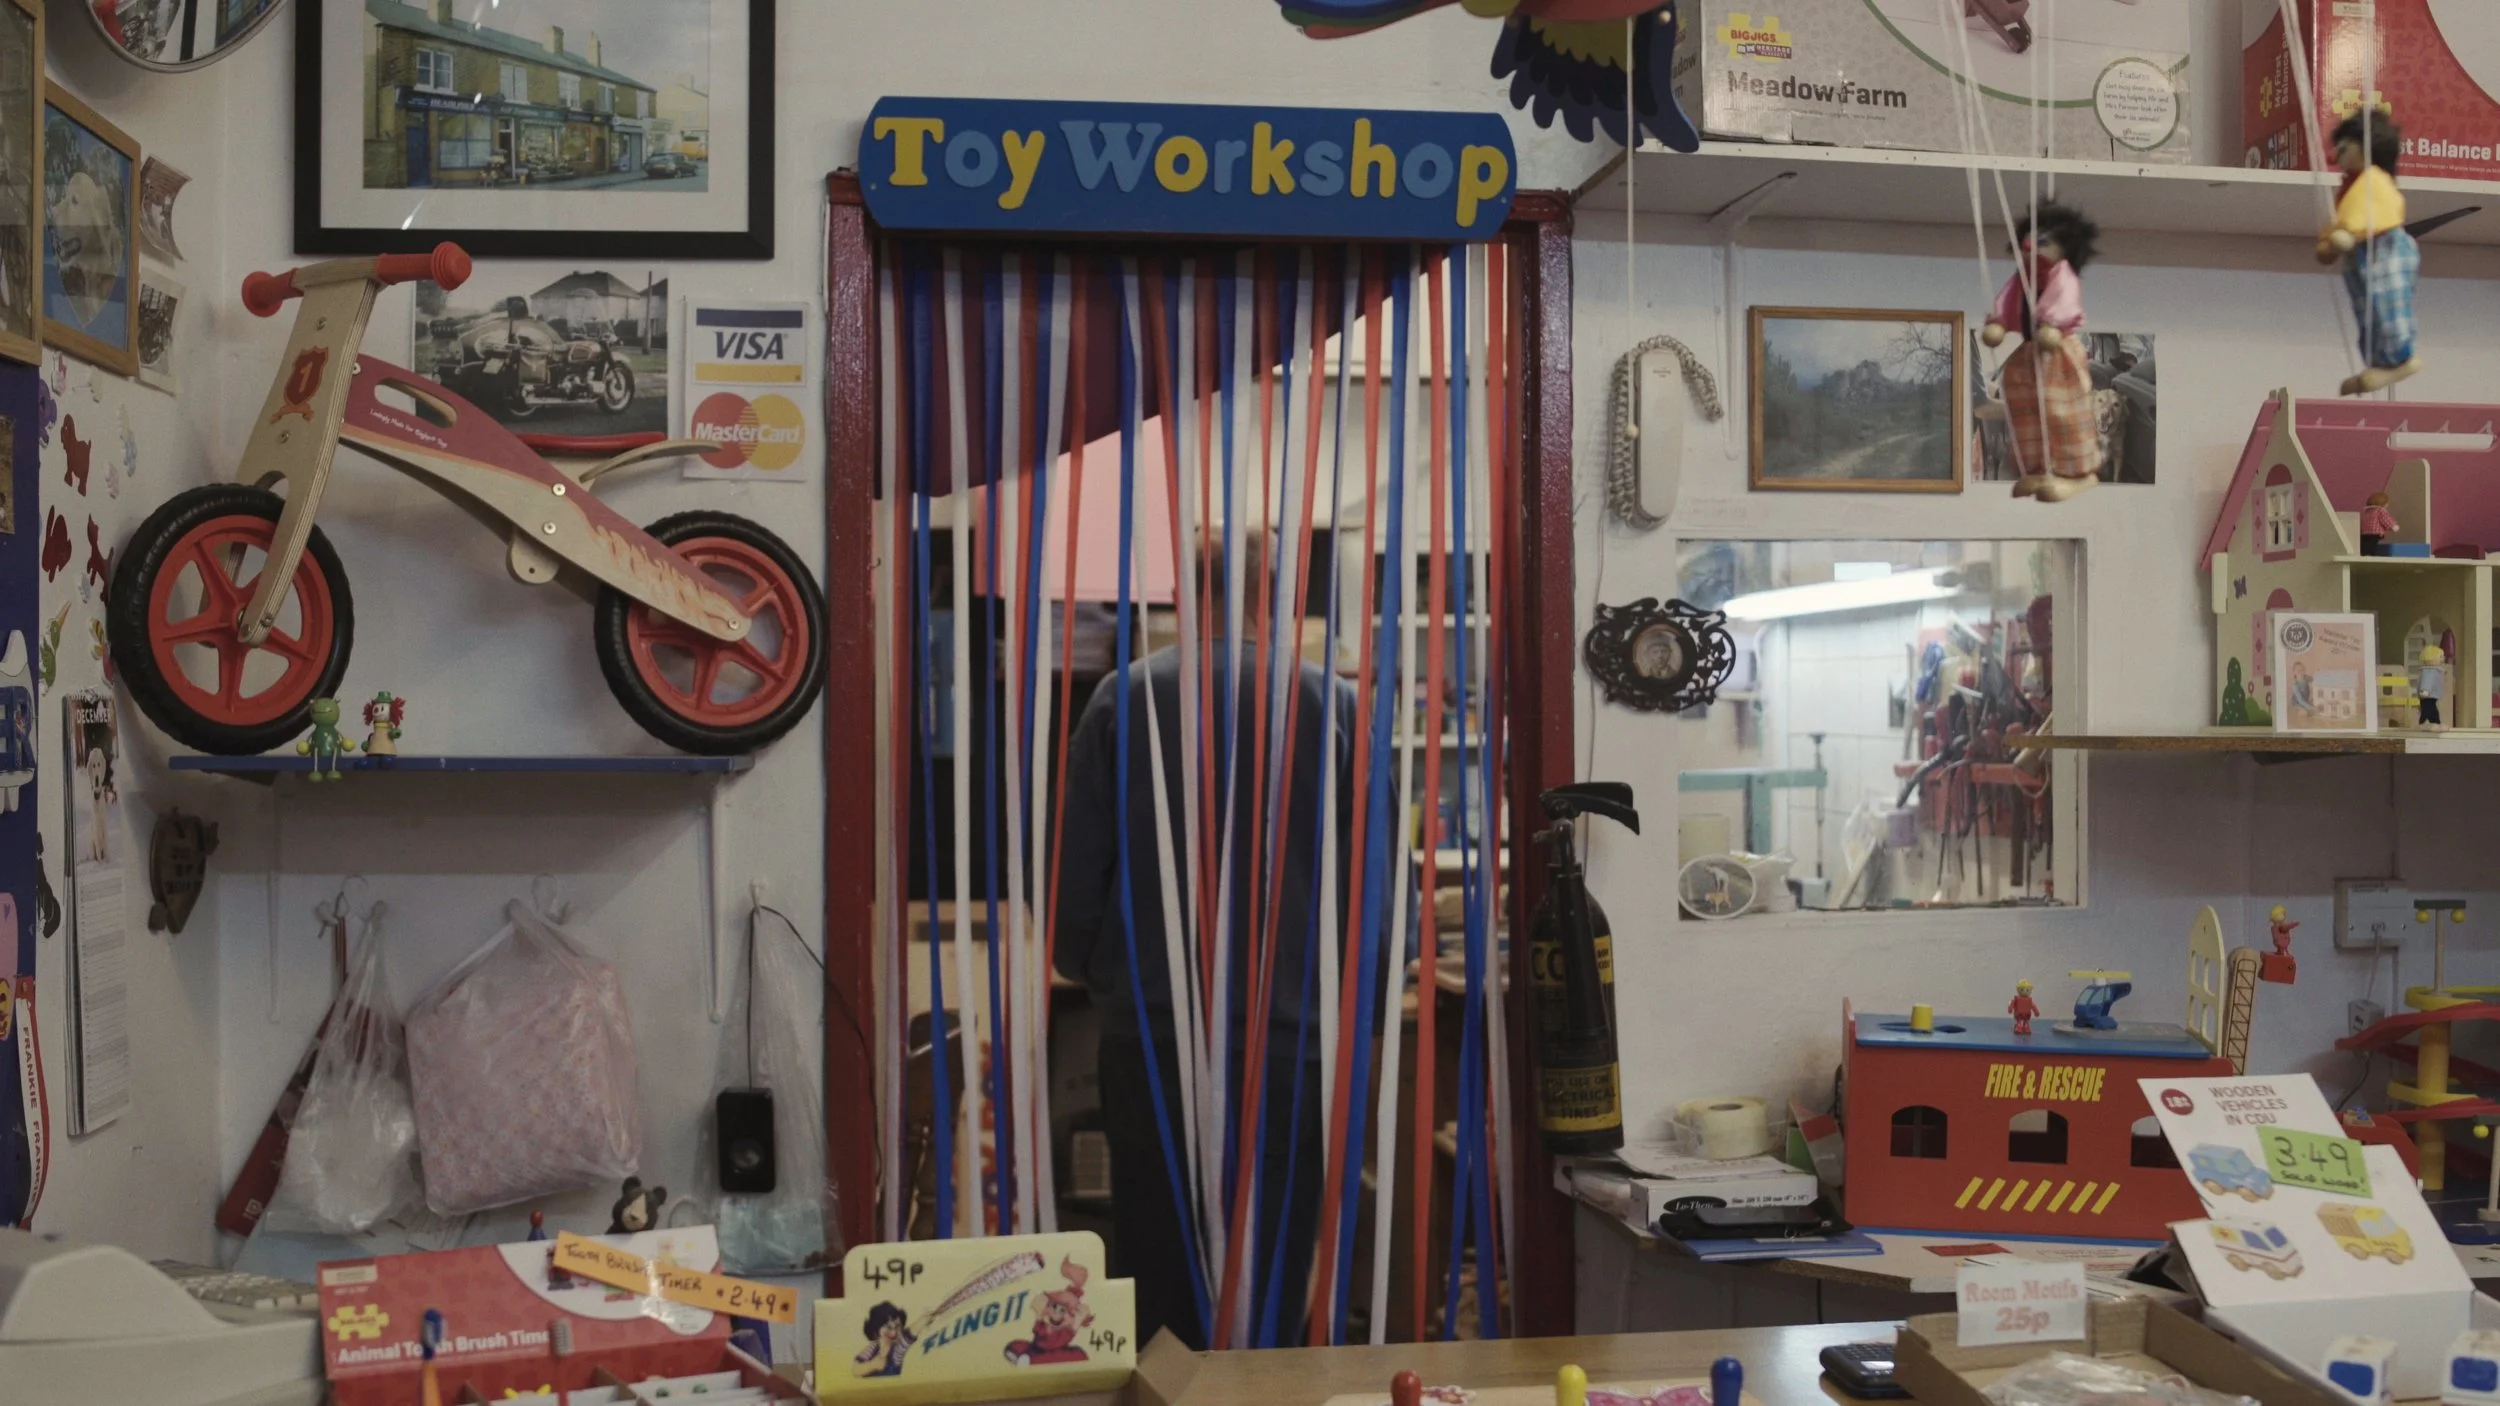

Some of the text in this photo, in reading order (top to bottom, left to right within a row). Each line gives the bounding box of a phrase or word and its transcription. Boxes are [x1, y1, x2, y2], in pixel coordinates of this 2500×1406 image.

[1727, 69, 1908, 108] Meadow Farm
[2417, 136, 2492, 161] Balance
[874, 116, 1509, 228] Toy Workshop
[715, 331, 784, 360] VISA
[695, 422, 802, 444] MasterCard
[22, 1026, 40, 1110] FRANKIE
[1984, 1063, 2107, 1102] FIRE & RESCUE
[2208, 1084, 2276, 1098] WOODEN
[2216, 1098, 2289, 1112] VEHICLES
[2225, 1112, 2277, 1125] IN CDU
[863, 1255, 925, 1291] 49p
[1964, 1276, 2079, 1302] Room Motifs
[921, 1289, 1030, 1356] FLING IT
[1995, 1306, 2051, 1336] 25p
[339, 1341, 402, 1365] Animal
[455, 1331, 509, 1353] Brush
[1089, 1329, 1127, 1354] 49p
